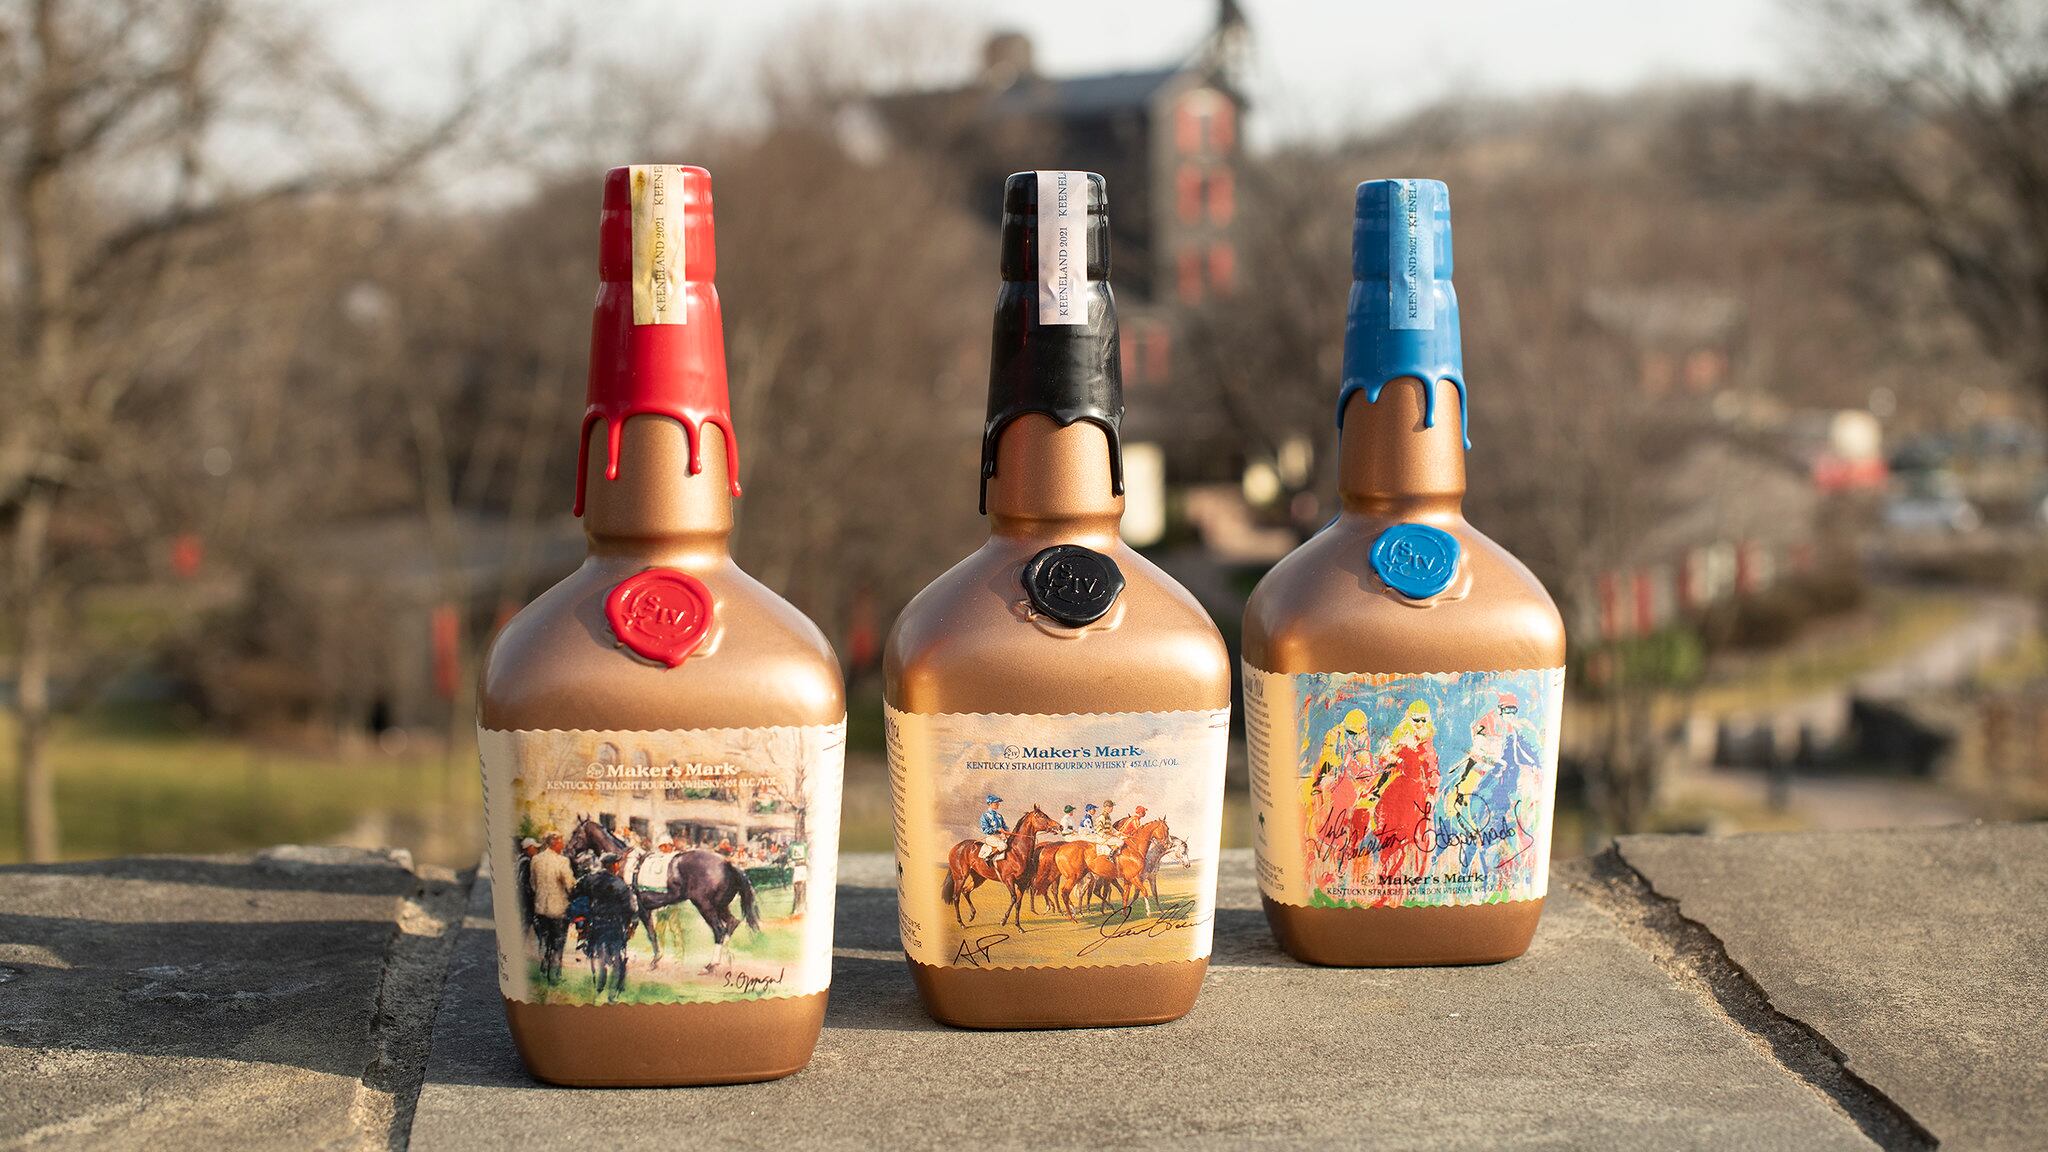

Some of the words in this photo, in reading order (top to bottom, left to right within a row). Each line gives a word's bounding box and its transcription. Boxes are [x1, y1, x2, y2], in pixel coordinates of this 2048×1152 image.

[1058, 171, 1068, 218] KEENEL
[656, 217, 665, 240] 2021
[1059, 226, 1068, 248] 2021
[1408, 237, 1418, 256] 2021
[655, 241, 667, 312] KEENELAND
[1059, 249, 1069, 317] KEENELAND
[1408, 256, 1418, 319] KEENELAND
[1022, 746, 1091, 759] Maker's
[1095, 745, 1141, 757] Mark
[606, 764, 682, 777] Maker's
[685, 762, 738, 776] Mark
[966, 761, 1010, 770] KENTUCKY
[1012, 761, 1053, 770] STRAIGHT
[1054, 761, 1093, 770] BOURBON
[546, 780, 595, 790] KENTUCKY
[596, 780, 640, 791] STRAIGHT
[641, 780, 683, 790] BOURBON
[1378, 874, 1440, 885] Maker's
[1443, 872, 1485, 884] Mark
[1326, 887, 1367, 896] KENTUCKY
[1368, 887, 1405, 896] STRAIGHT
